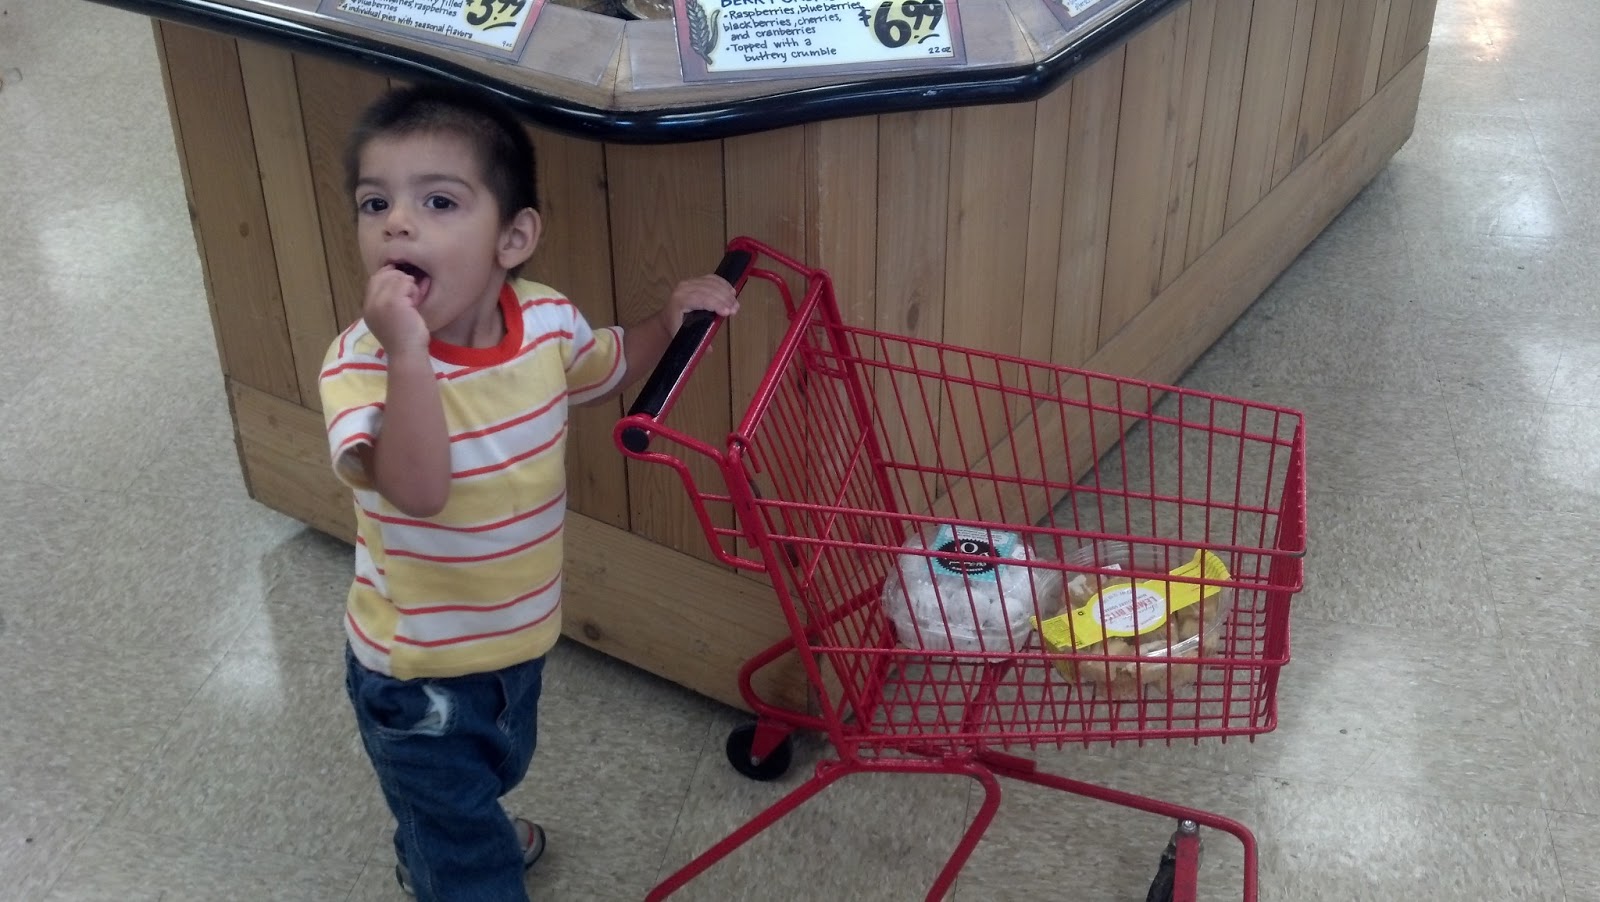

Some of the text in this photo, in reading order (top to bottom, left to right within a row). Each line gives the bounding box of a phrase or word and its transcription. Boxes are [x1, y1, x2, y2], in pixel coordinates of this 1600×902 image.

[414, 3, 457, 17] raspberries
[348, 3, 381, 18] individual
[381, 12, 396, 22] pies
[397, 14, 412, 26] with
[414, 20, 445, 32] seasonal
[446, 25, 473, 39] flavors
[731, 26, 816, 42] and cranberries
[730, 37, 812, 53] Topped with a
[743, 46, 837, 62] buttery crumble
